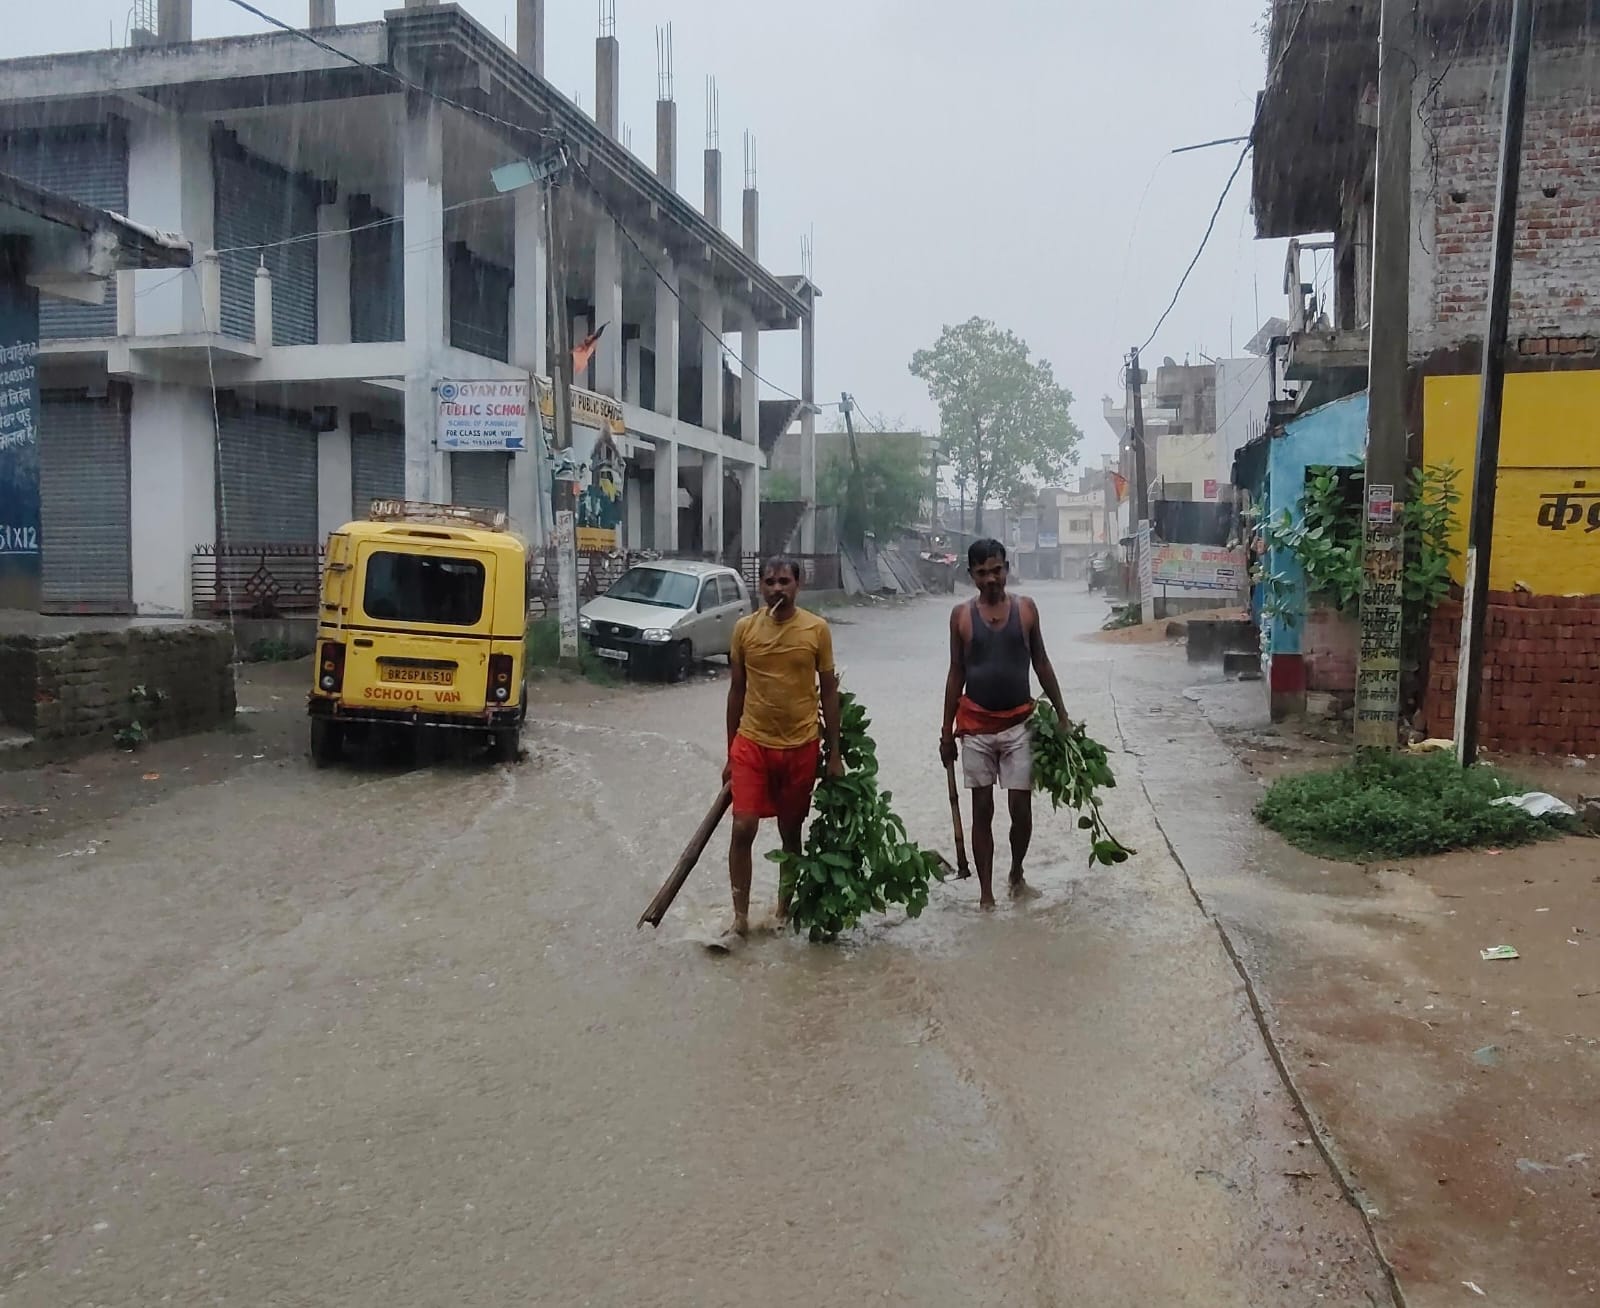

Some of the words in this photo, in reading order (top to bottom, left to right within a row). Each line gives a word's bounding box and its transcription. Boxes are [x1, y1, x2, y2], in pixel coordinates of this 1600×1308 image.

[460, 384, 497, 397] GYAN
[440, 403, 481, 416] PUBLIC
[486, 403, 526, 416] SCHOOL
[578, 394, 600, 416] PUBLIC
[446, 429, 458, 437] FOR
[460, 429, 481, 437] CLASS
[363, 687, 424, 701] SCHOOL
[435, 691, 461, 702] VAN
